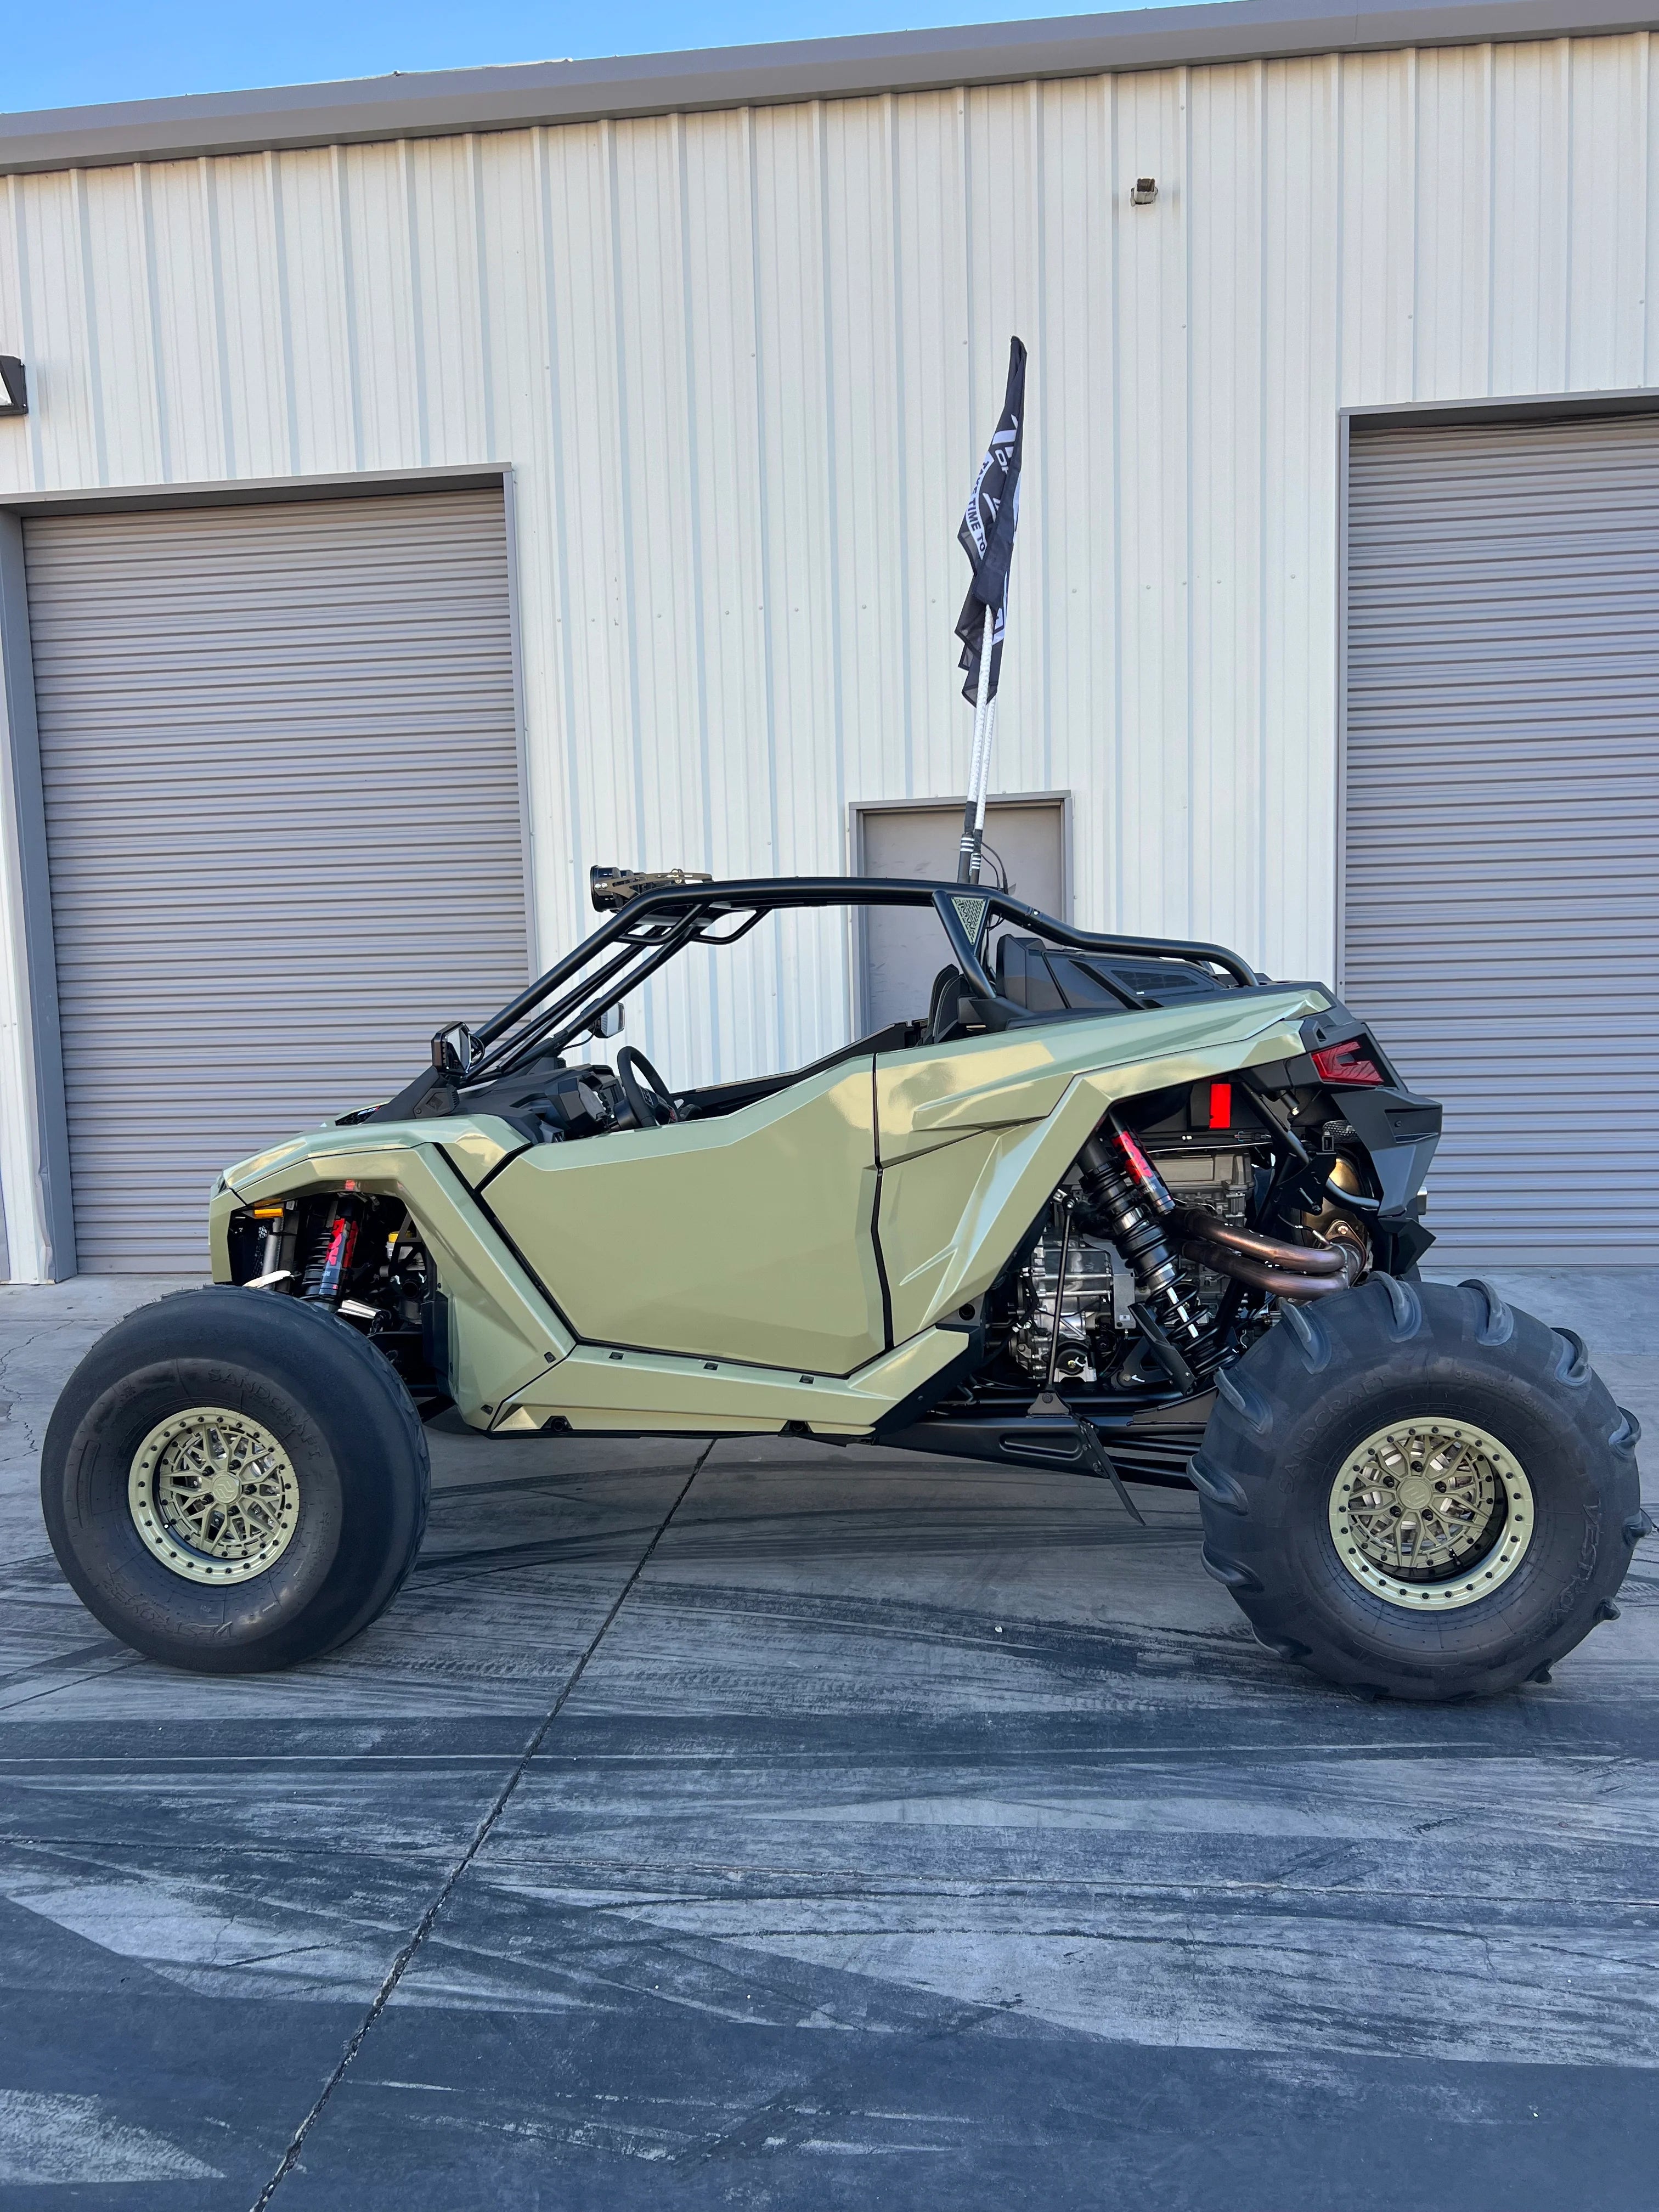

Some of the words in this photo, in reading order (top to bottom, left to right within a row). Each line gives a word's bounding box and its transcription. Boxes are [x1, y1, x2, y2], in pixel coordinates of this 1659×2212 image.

[968, 497, 981, 531] TIME
[977, 532, 986, 552] TO
[1111, 1131, 1154, 1185] FOX
[208, 1368, 324, 1460] SANDCRAFT
[1279, 1373, 1391, 1494] SANDCRAFT
